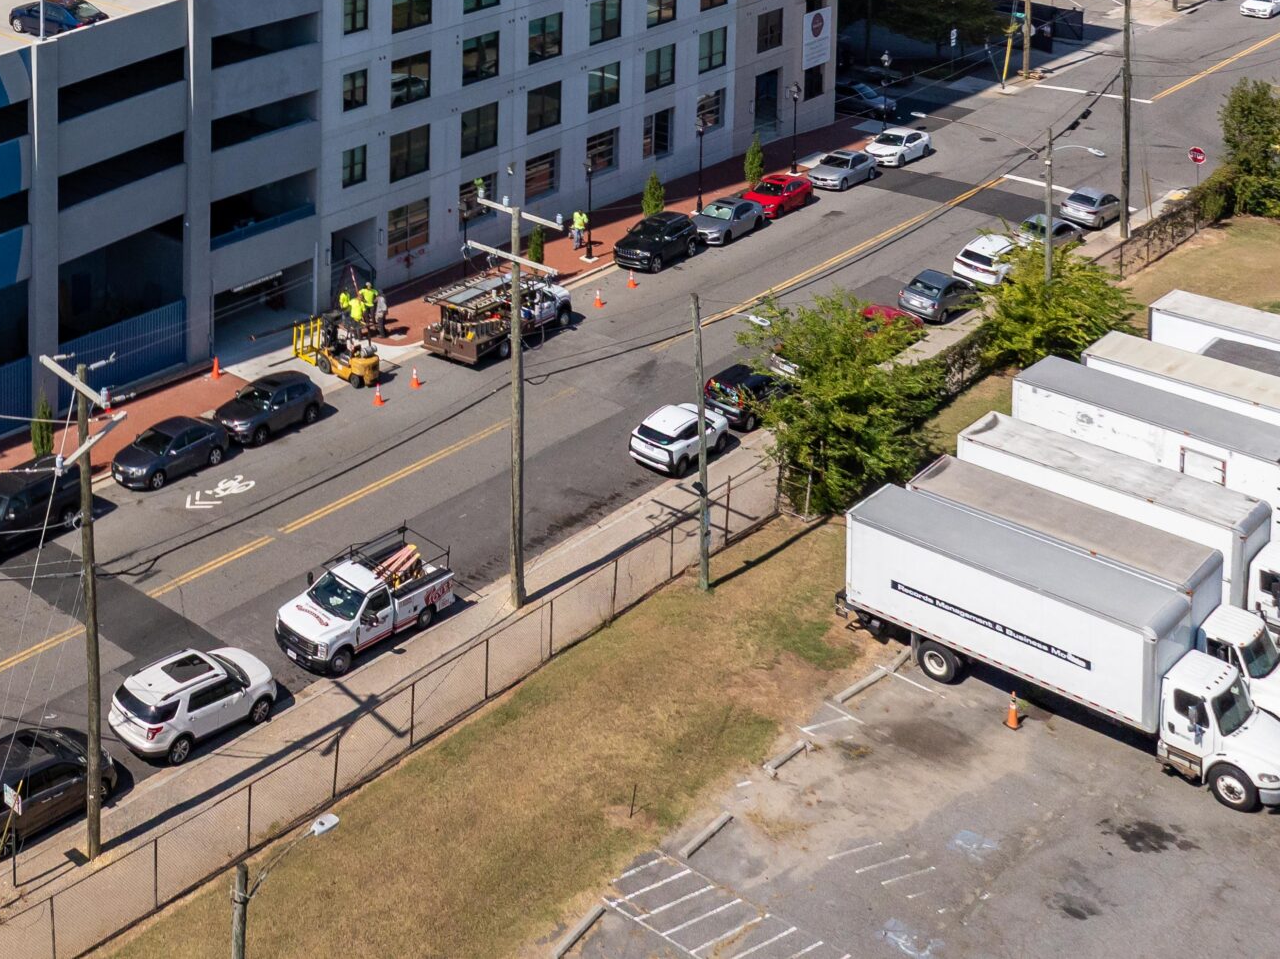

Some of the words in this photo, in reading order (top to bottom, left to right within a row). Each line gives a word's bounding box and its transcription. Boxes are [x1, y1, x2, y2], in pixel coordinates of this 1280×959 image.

[897, 583, 934, 604] Records
[935, 599, 993, 629] Management
[1005, 627, 1049, 651] Business
